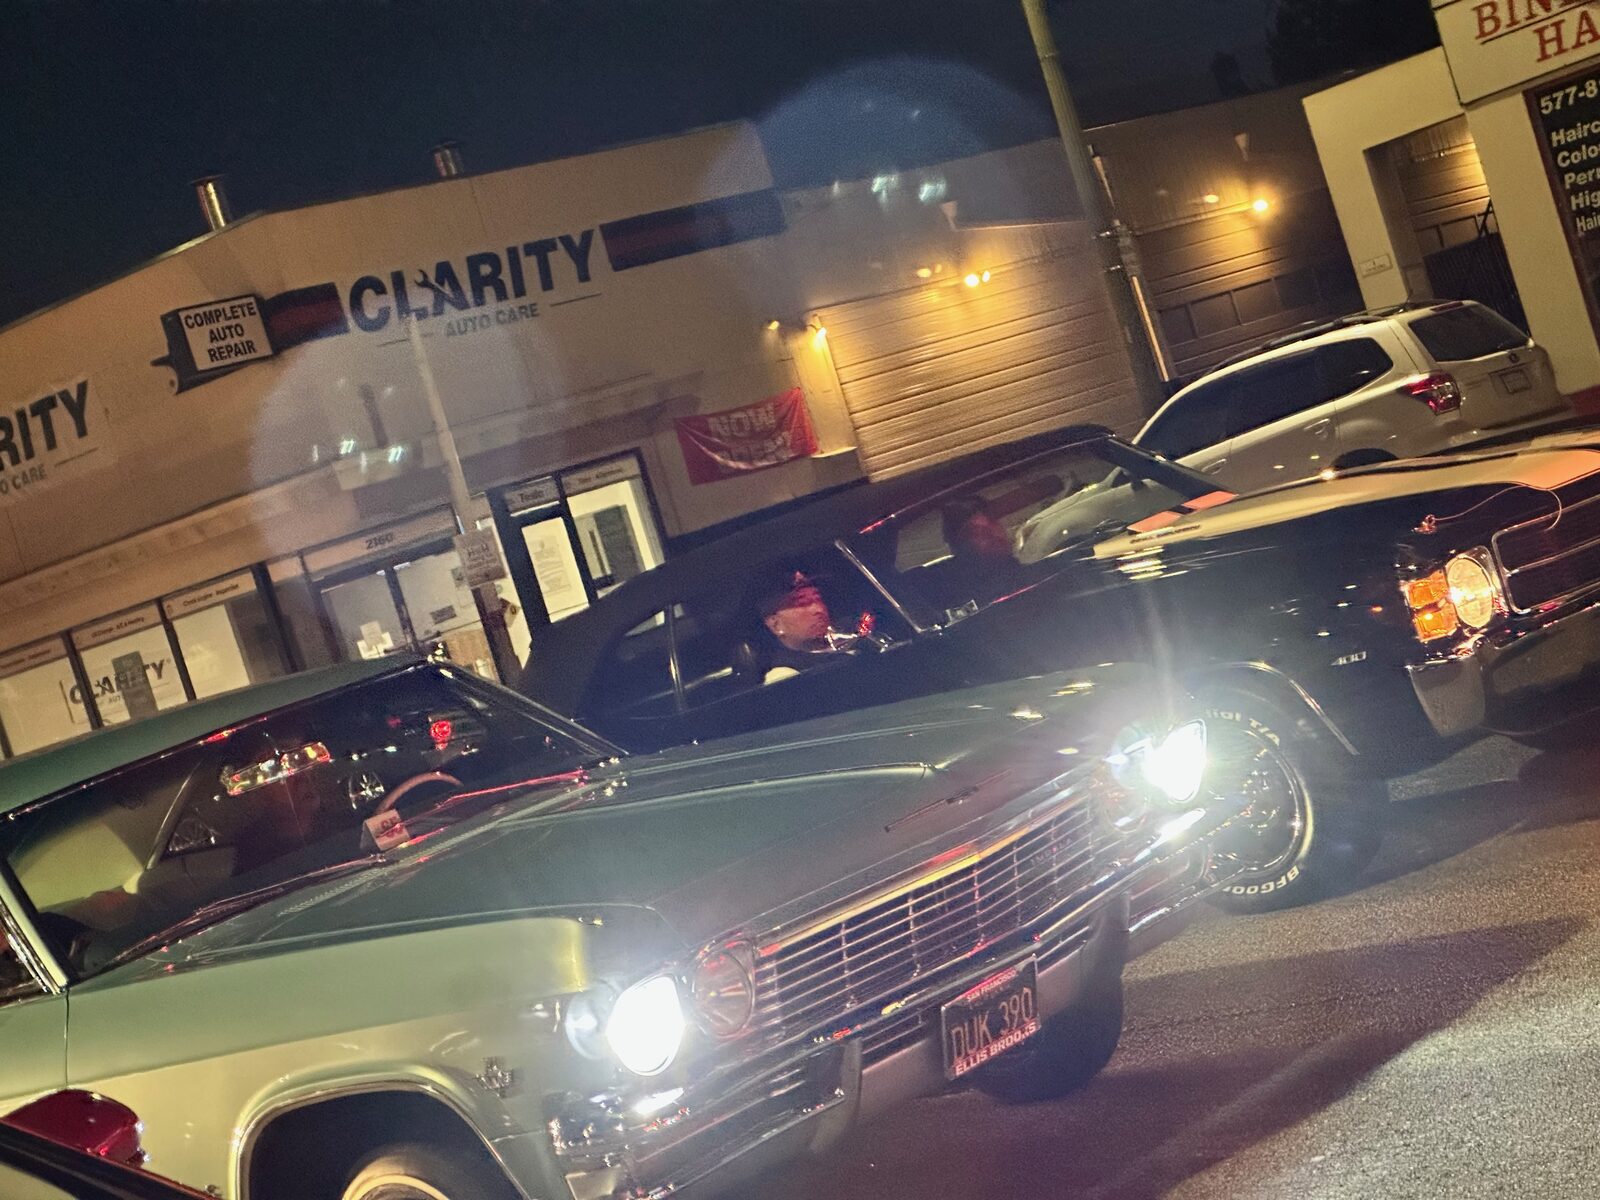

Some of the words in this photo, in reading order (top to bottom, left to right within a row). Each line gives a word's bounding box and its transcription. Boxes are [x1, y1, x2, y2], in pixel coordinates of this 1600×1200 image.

[1471, 0, 1582, 40] BIN
[1541, 79, 1600, 115] 577-8
[1557, 143, 1600, 168] Colo
[349, 229, 595, 333] CLARITY
[183, 301, 257, 329] COMPLETE
[446, 313, 491, 336] AUTO
[495, 302, 540, 325] CARE
[208, 322, 245, 344] AUTO
[207, 339, 257, 363] REPAIR
[0, 379, 88, 472] RITY
[12, 463, 48, 490] CARE
[955, 1049, 988, 1077] ELLIS
